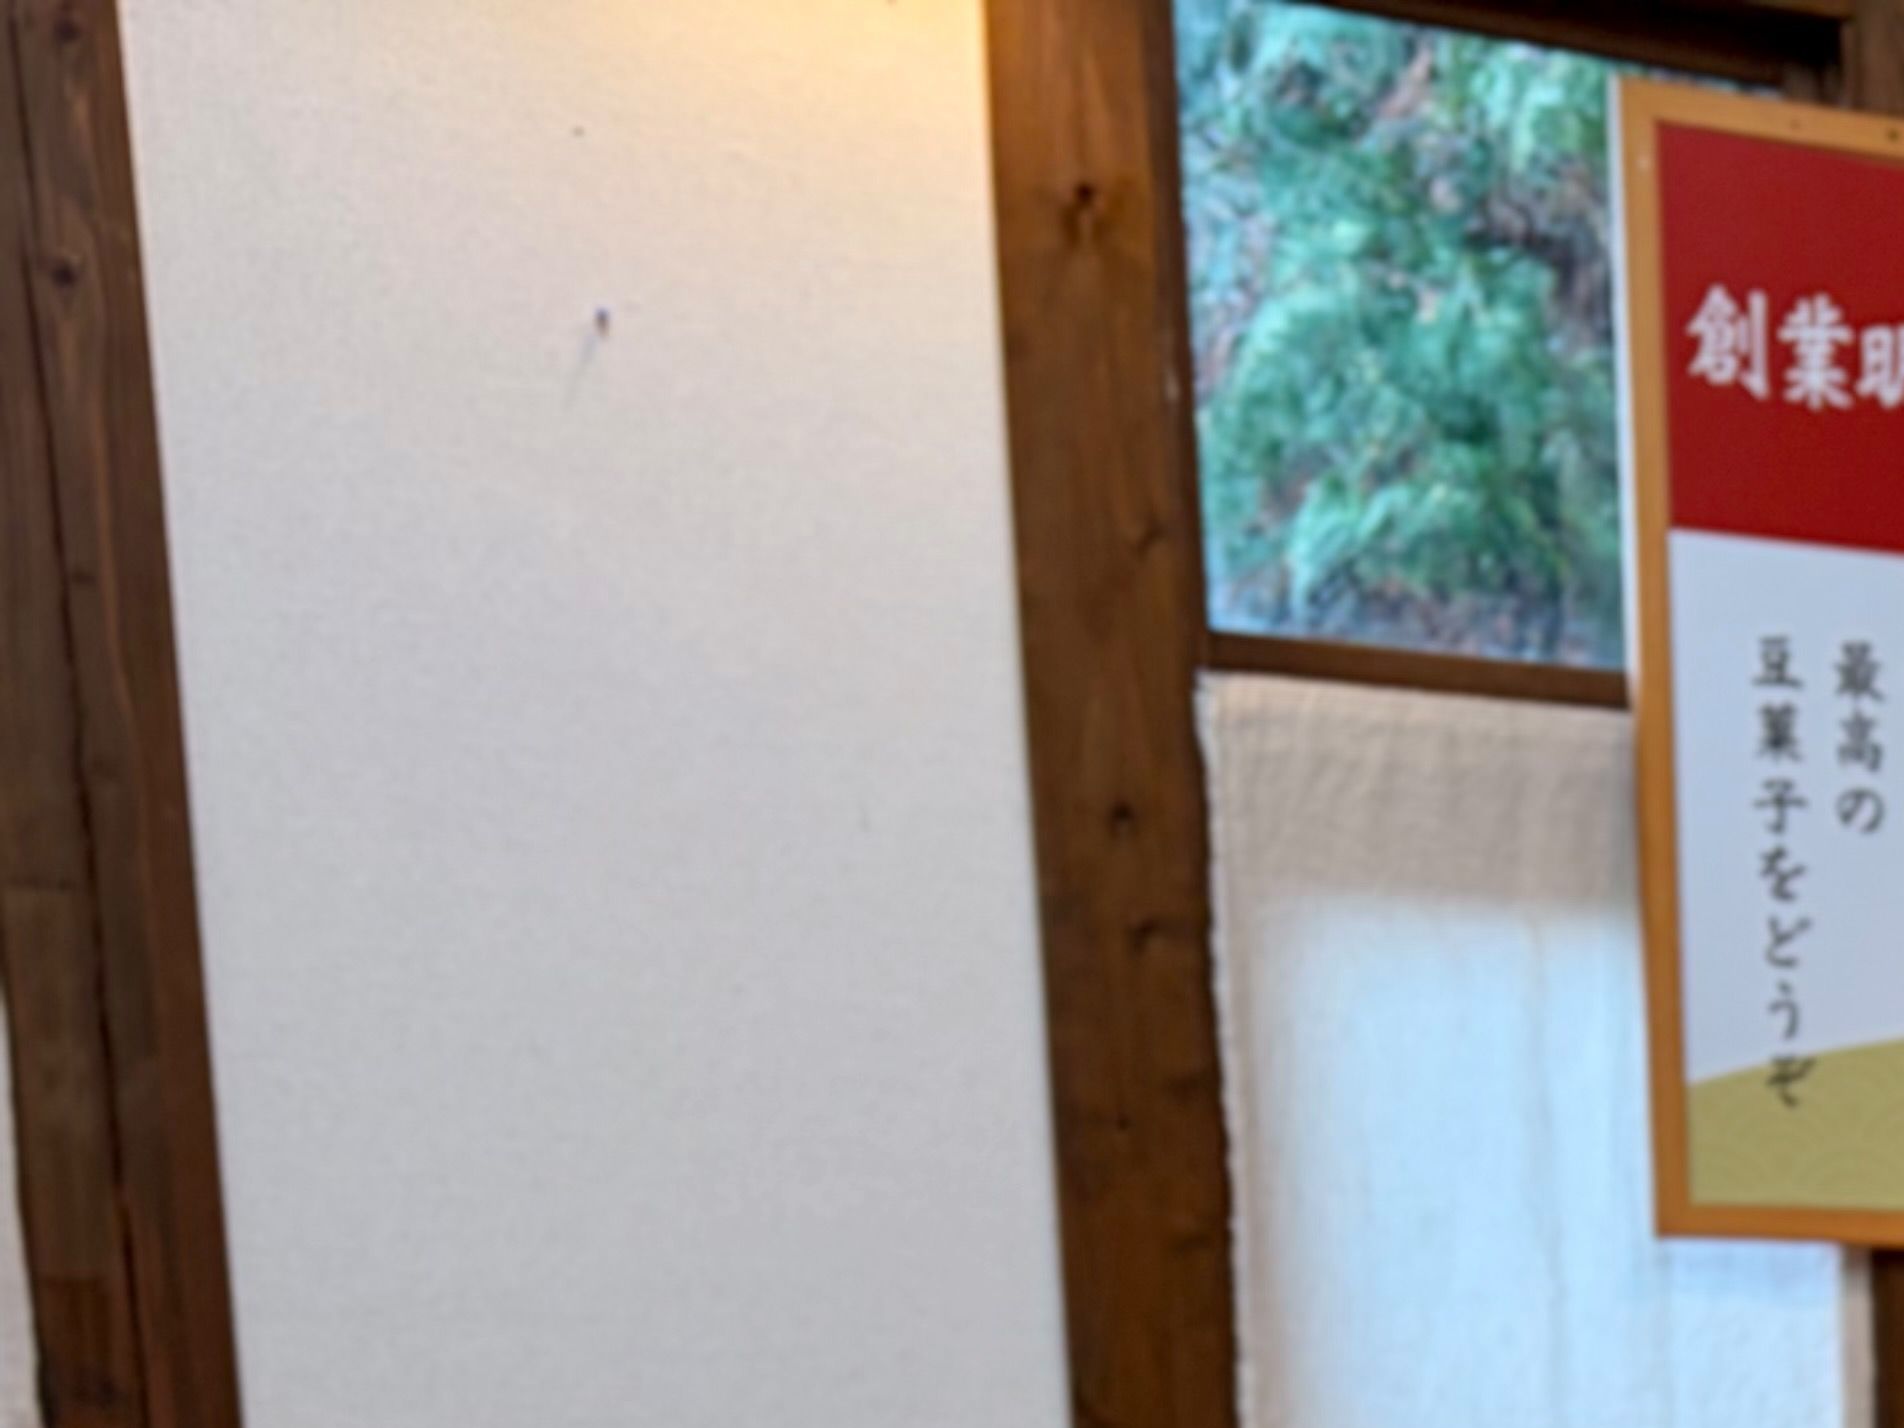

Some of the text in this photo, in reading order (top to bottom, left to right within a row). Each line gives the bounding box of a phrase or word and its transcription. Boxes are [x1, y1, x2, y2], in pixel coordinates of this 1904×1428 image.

[1750, 634, 1813, 1111] 豆菓子をどうぞ
[1834, 642, 1884, 834] 最高の
